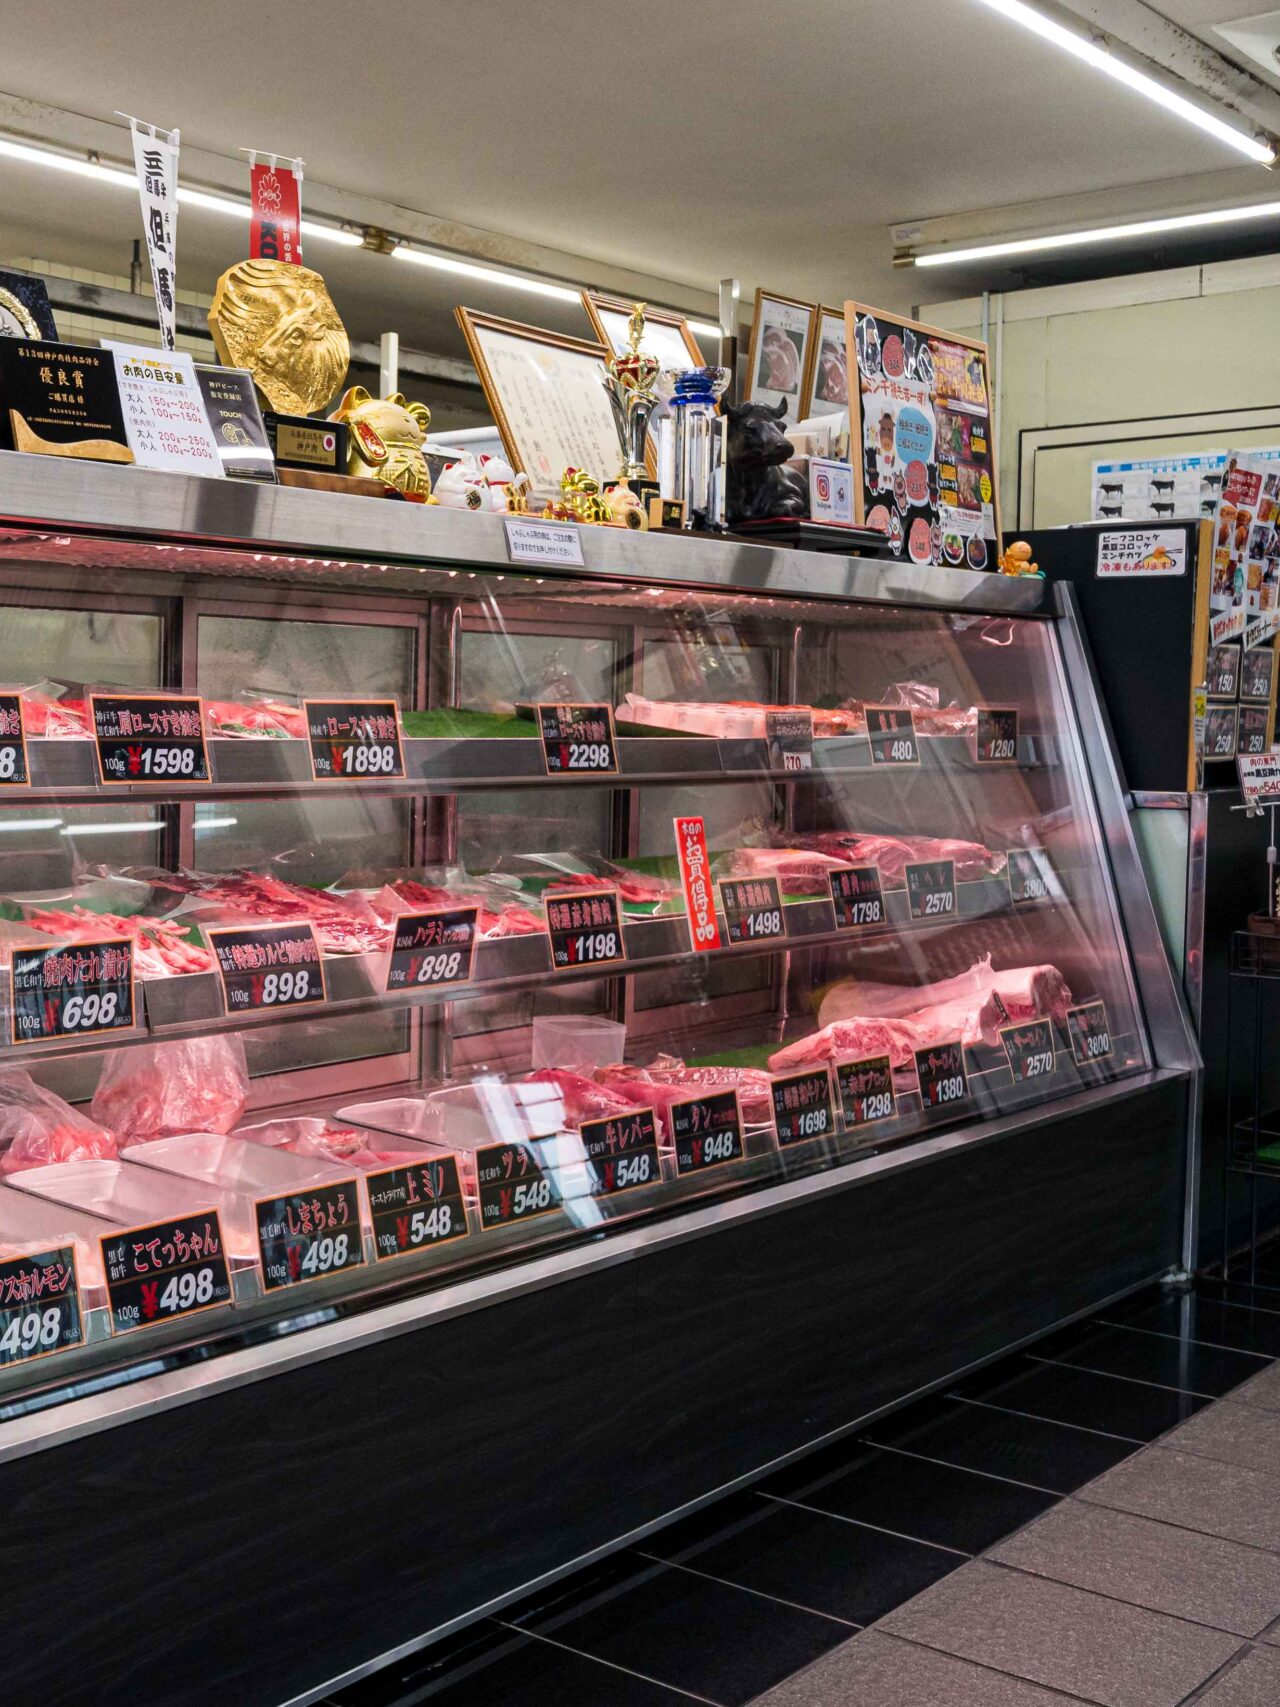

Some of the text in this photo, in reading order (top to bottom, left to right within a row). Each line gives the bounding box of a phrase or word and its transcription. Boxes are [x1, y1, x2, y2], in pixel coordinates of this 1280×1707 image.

[40, 367, 84, 388] 優良賞
[123, 364, 186, 385] お肉の目安量
[127, 393, 144, 403] 大人
[130, 405, 146, 415] 小人
[137, 429, 154, 439] 大人
[140, 441, 157, 451] 小人
[1103, 534, 1160, 542] ビーフコロッケ
[1102, 552, 1142, 560] ミンチカツ
[1252, 679, 1267, 695] 250
[117, 709, 200, 736] 肩ロースすき焼き
[1215, 736, 1230, 752] 250
[1249, 736, 1263, 751] 250
[43, 947, 130, 987] 焼肉たれ漬け
[606, 1116, 652, 1154] 牛レバー
[407, 1166, 443, 1204] 上ミノ
[286, 1194, 348, 1235] しまちょう
[132, 1223, 218, 1271] こてっちゃん
[108, 1247, 125, 1264] 黒毛
[111, 1264, 126, 1280] 和牛
[118, 1305, 139, 1320] 100g
